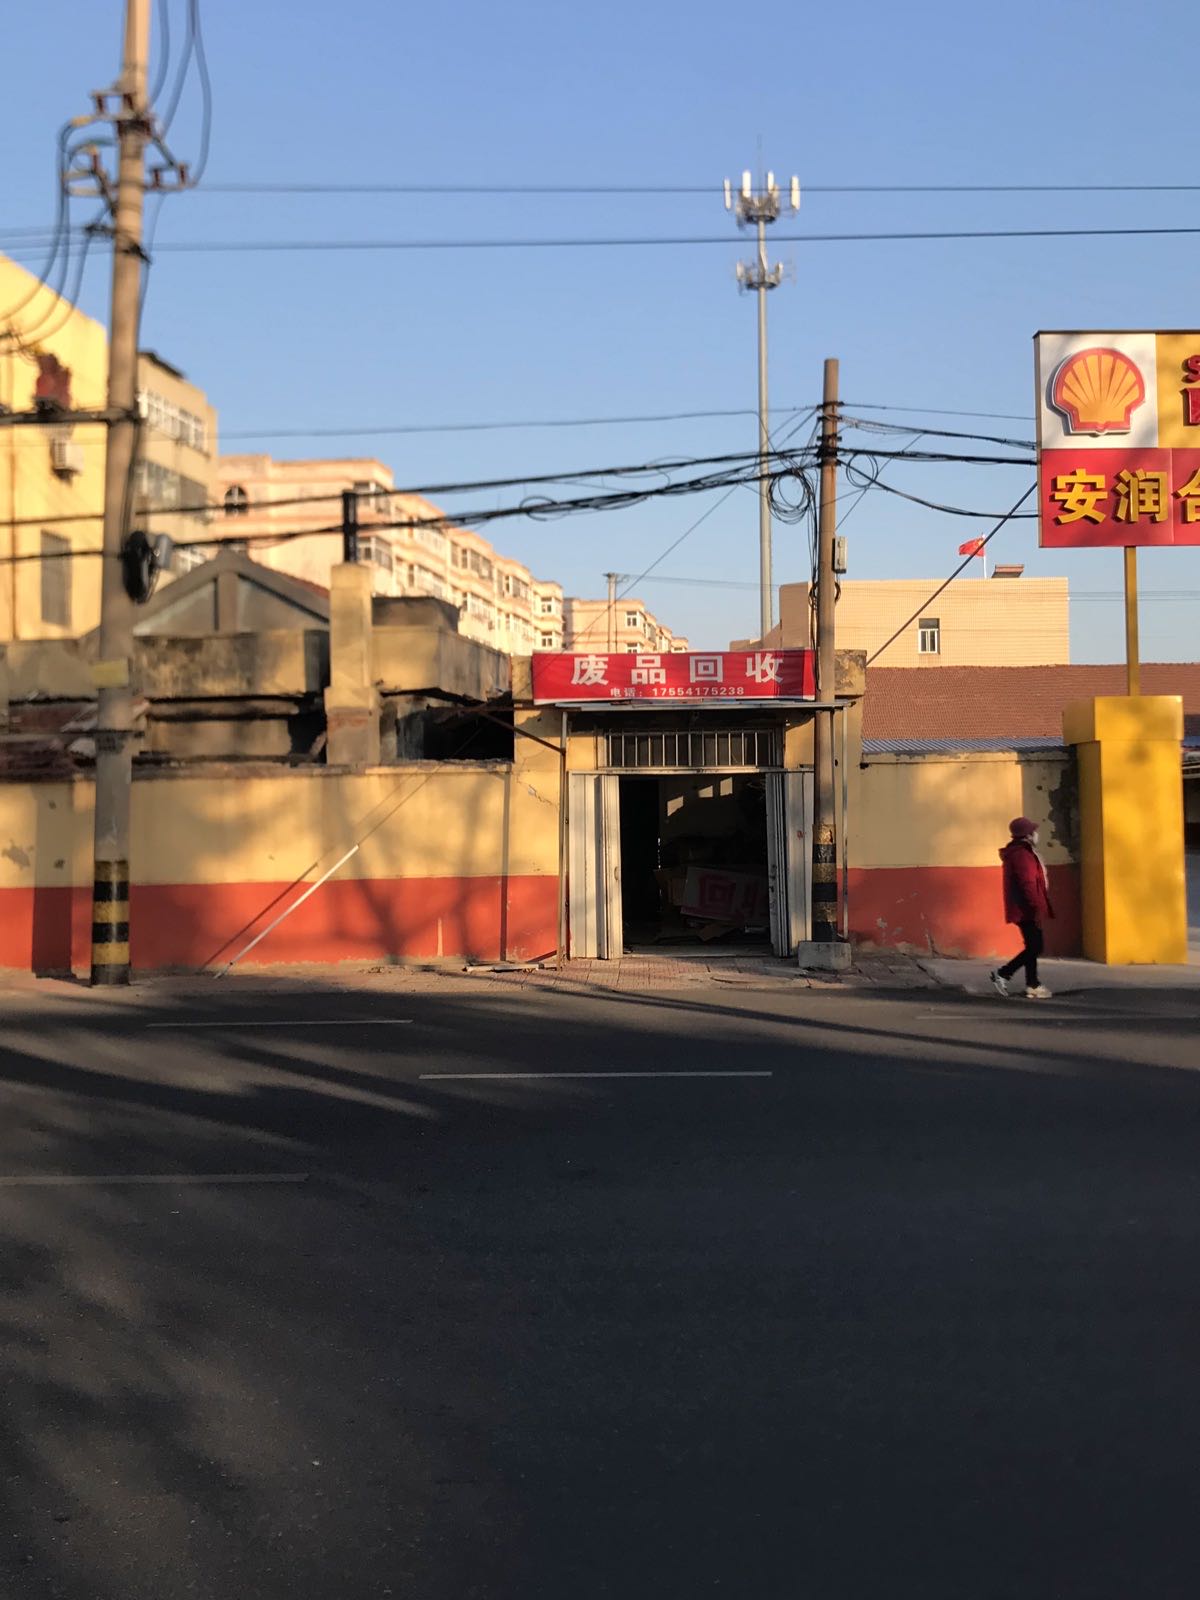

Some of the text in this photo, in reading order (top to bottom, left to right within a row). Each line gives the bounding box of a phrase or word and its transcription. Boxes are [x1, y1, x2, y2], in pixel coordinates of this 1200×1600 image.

[571, 654, 784, 686] 废品回收
[652, 686, 745, 697] 17554175238
